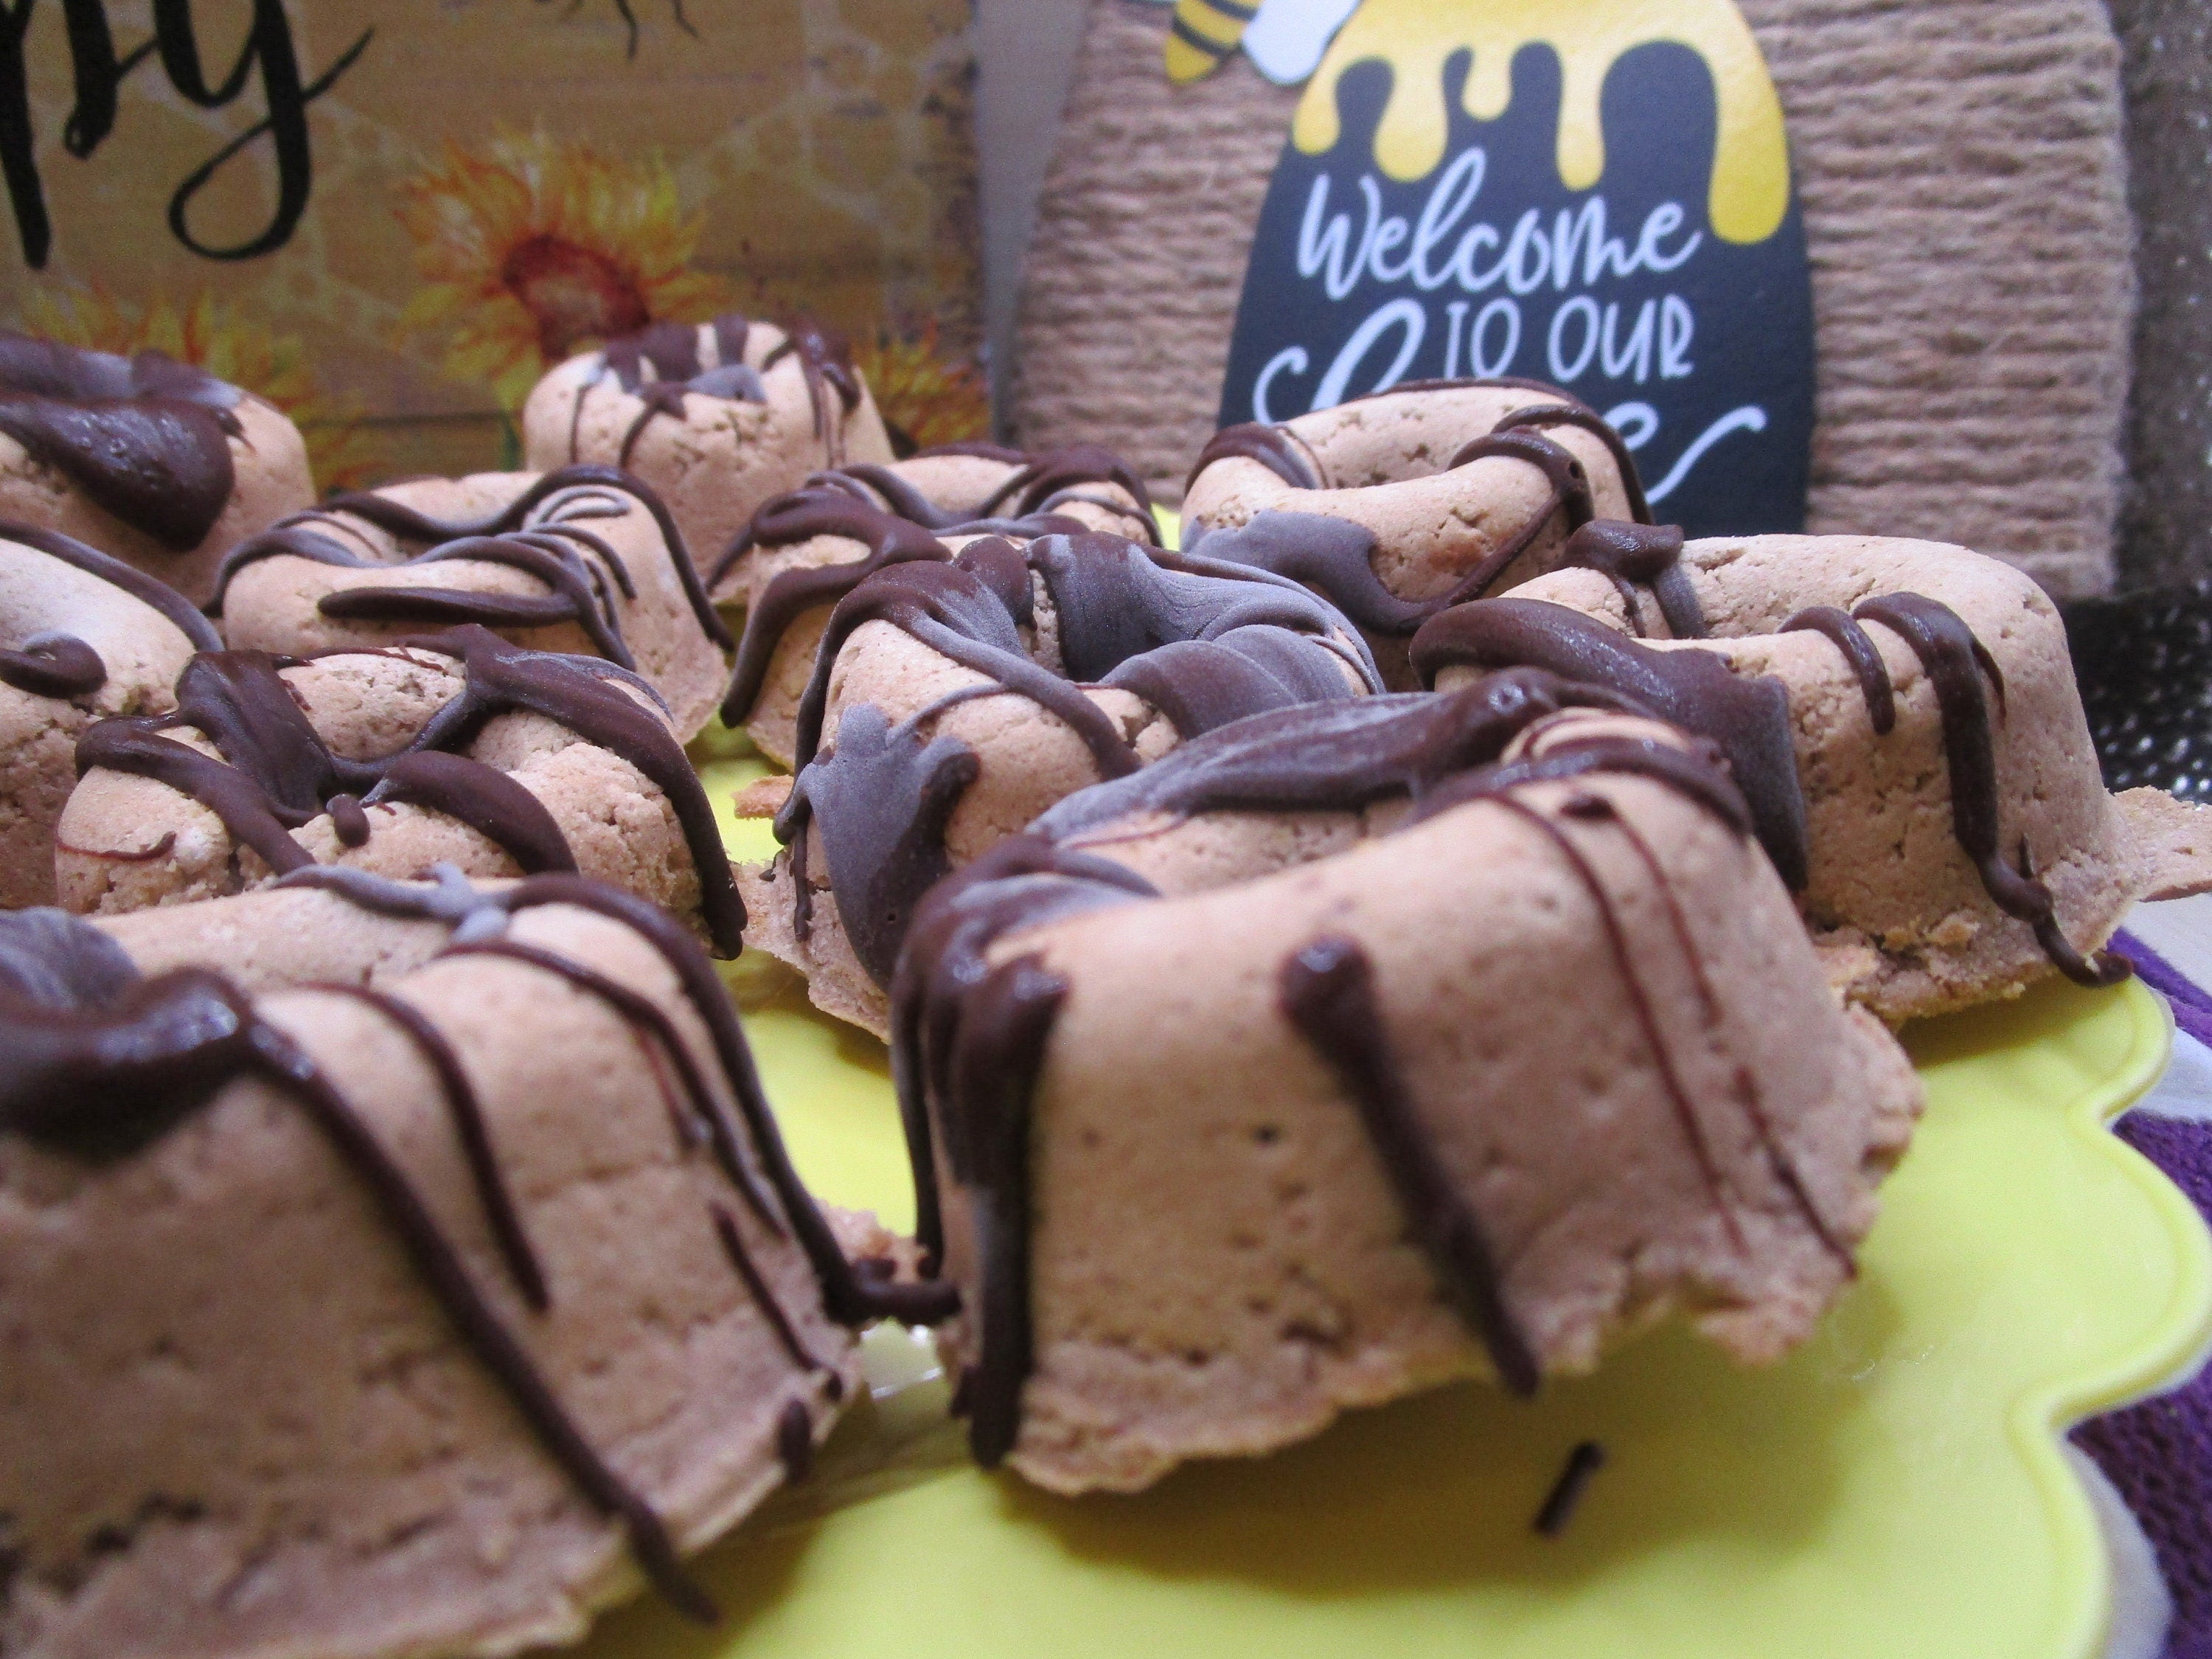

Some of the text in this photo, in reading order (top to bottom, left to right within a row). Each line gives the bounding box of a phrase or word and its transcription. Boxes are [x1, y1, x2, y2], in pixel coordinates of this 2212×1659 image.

[1298, 148, 1702, 299] Welcome
[1444, 296, 1694, 383] TO OUR
